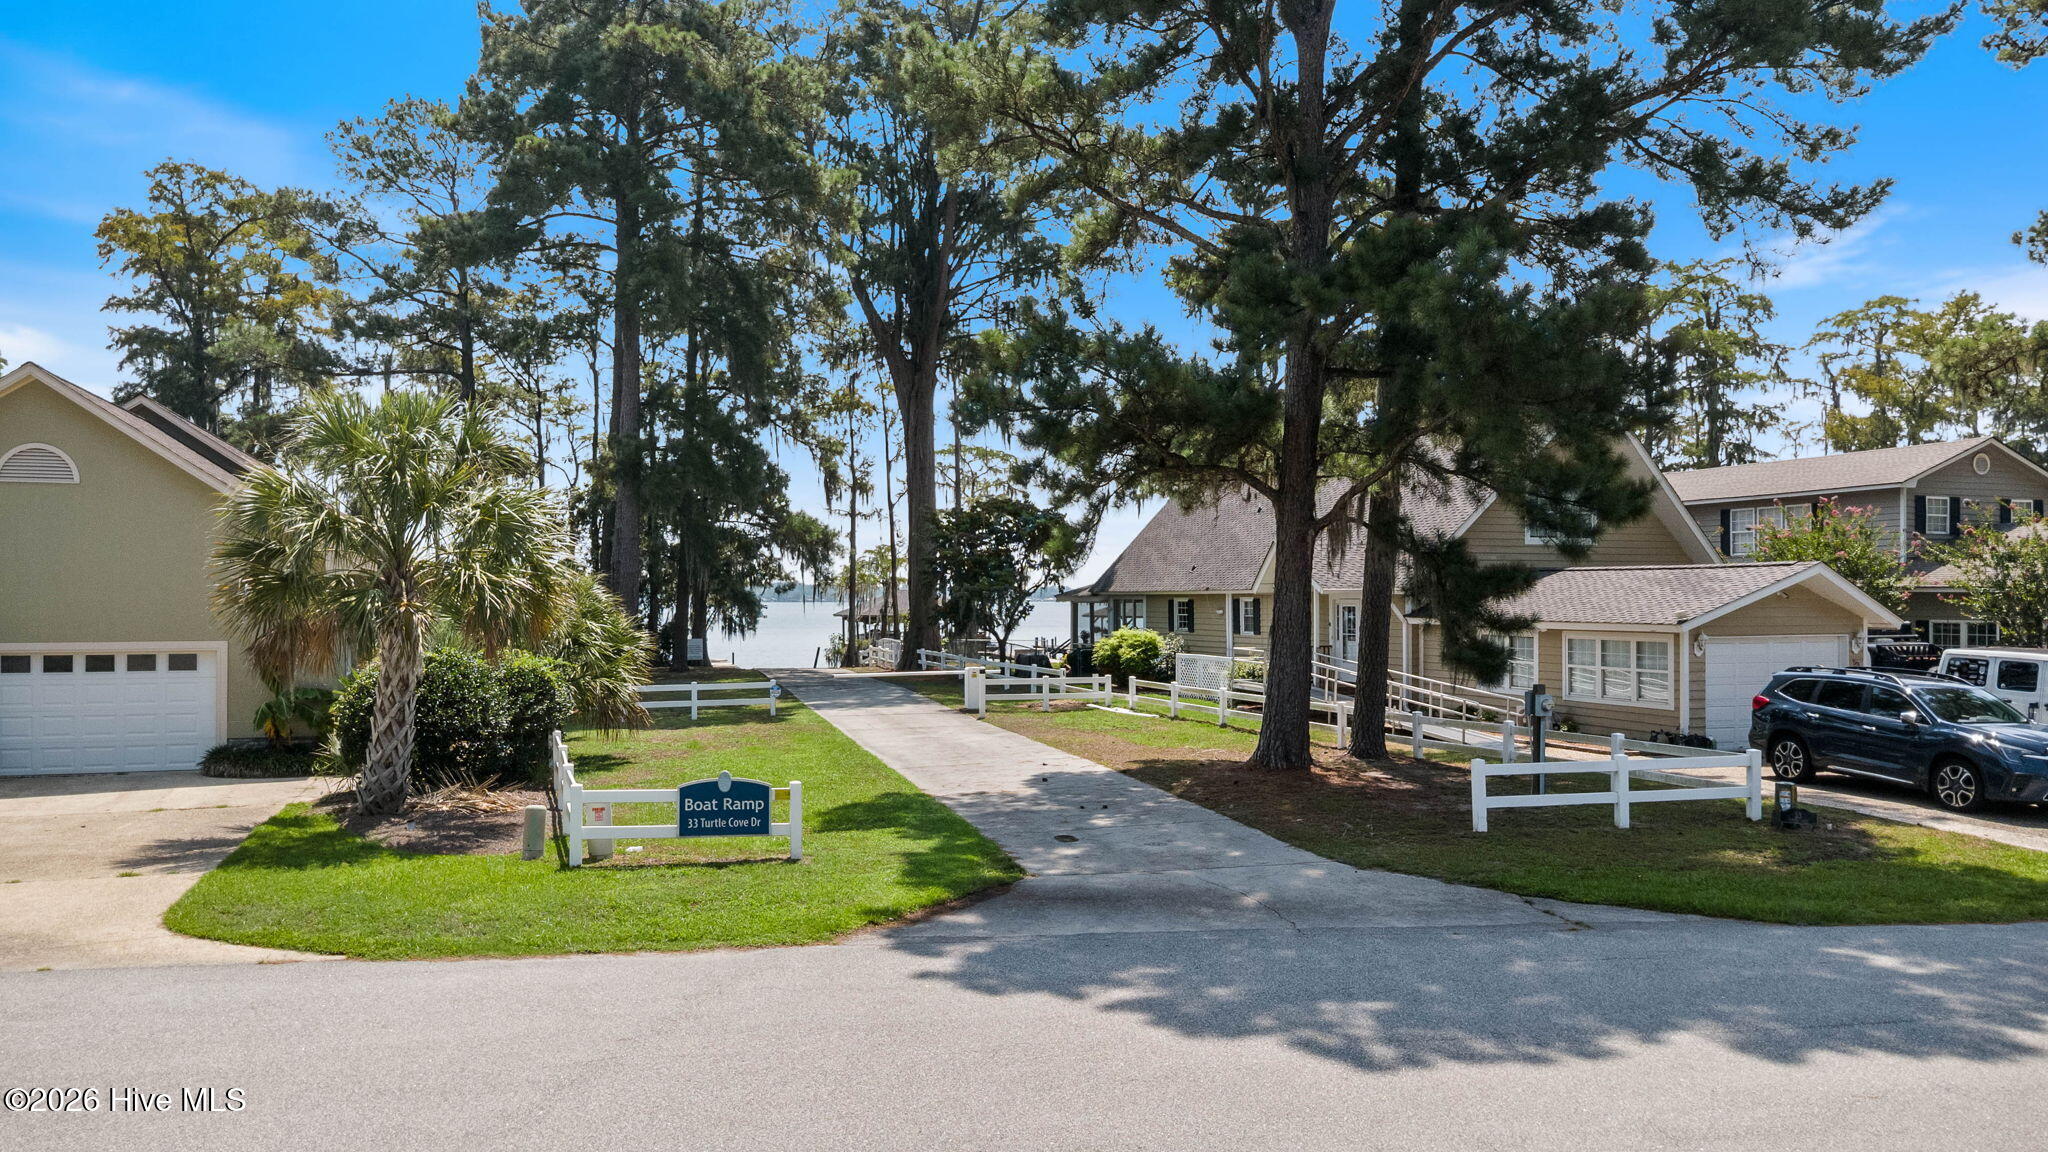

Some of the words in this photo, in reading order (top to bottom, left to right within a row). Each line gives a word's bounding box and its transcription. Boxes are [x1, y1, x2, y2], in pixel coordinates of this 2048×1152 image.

[684, 798, 718, 811] Boat
[723, 797, 765, 813] Ramp
[687, 818, 699, 829] 33
[700, 817, 727, 828] Turtle
[728, 817, 749, 827] Cove
[750, 816, 761, 827] Dr
